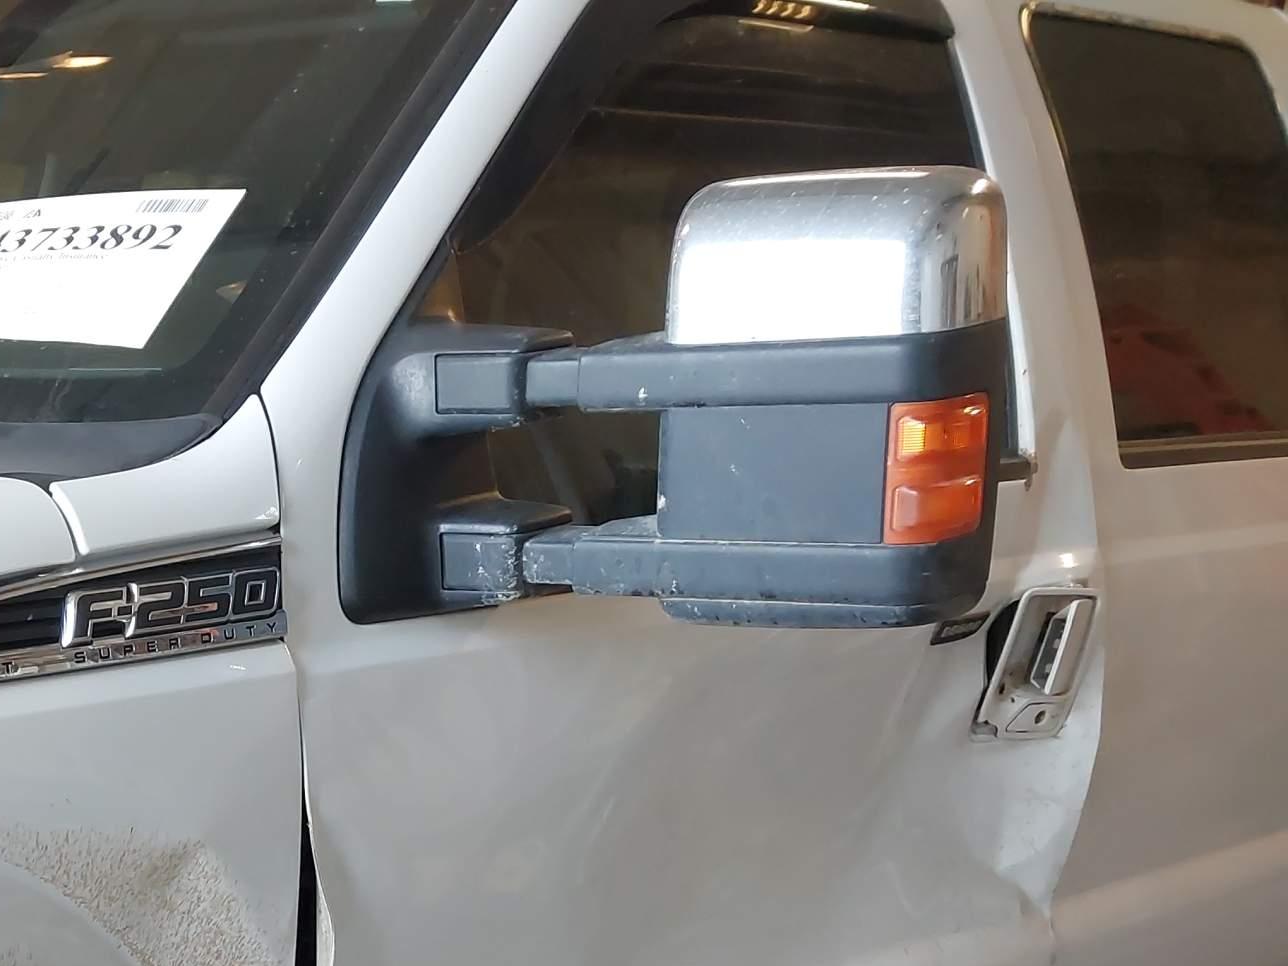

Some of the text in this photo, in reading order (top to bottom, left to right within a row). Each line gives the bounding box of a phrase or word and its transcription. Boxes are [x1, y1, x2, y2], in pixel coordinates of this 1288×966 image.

[61, 567, 280, 648] F-250
[73, 622, 278, 665] SUPER DUTY
